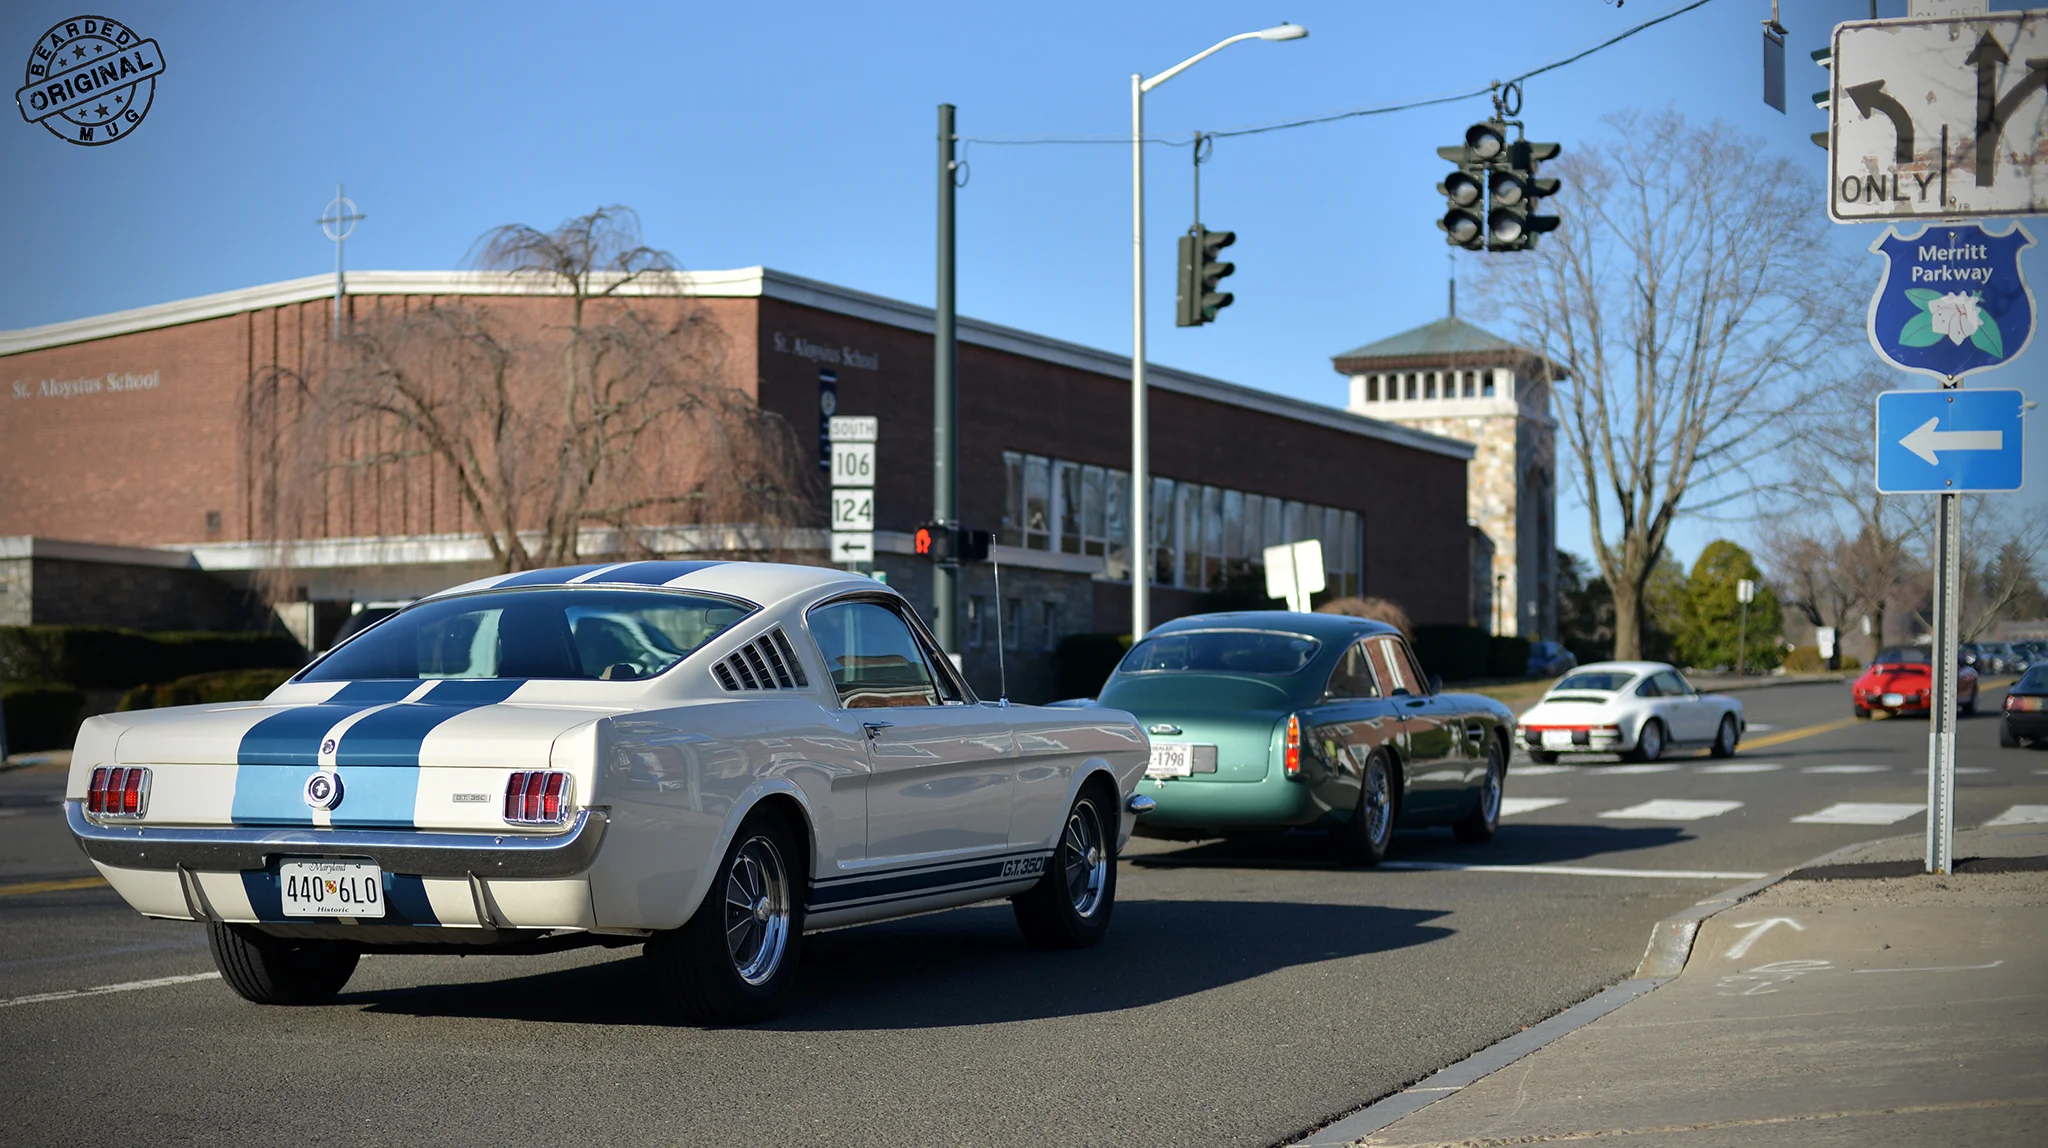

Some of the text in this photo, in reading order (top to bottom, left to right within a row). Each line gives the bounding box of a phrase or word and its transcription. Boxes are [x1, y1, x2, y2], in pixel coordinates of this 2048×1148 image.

[1841, 171, 1936, 203] ONLY
[1918, 243, 1987, 262] Merritt
[1912, 265, 1993, 284] Parkway
[36, 376, 102, 400] Aloysius
[107, 369, 160, 393] School
[832, 422, 875, 435] SOUTH
[838, 452, 870, 476] 106
[834, 498, 872, 522] 124
[309, 862, 347, 874] Maryland
[287, 876, 324, 902] 440
